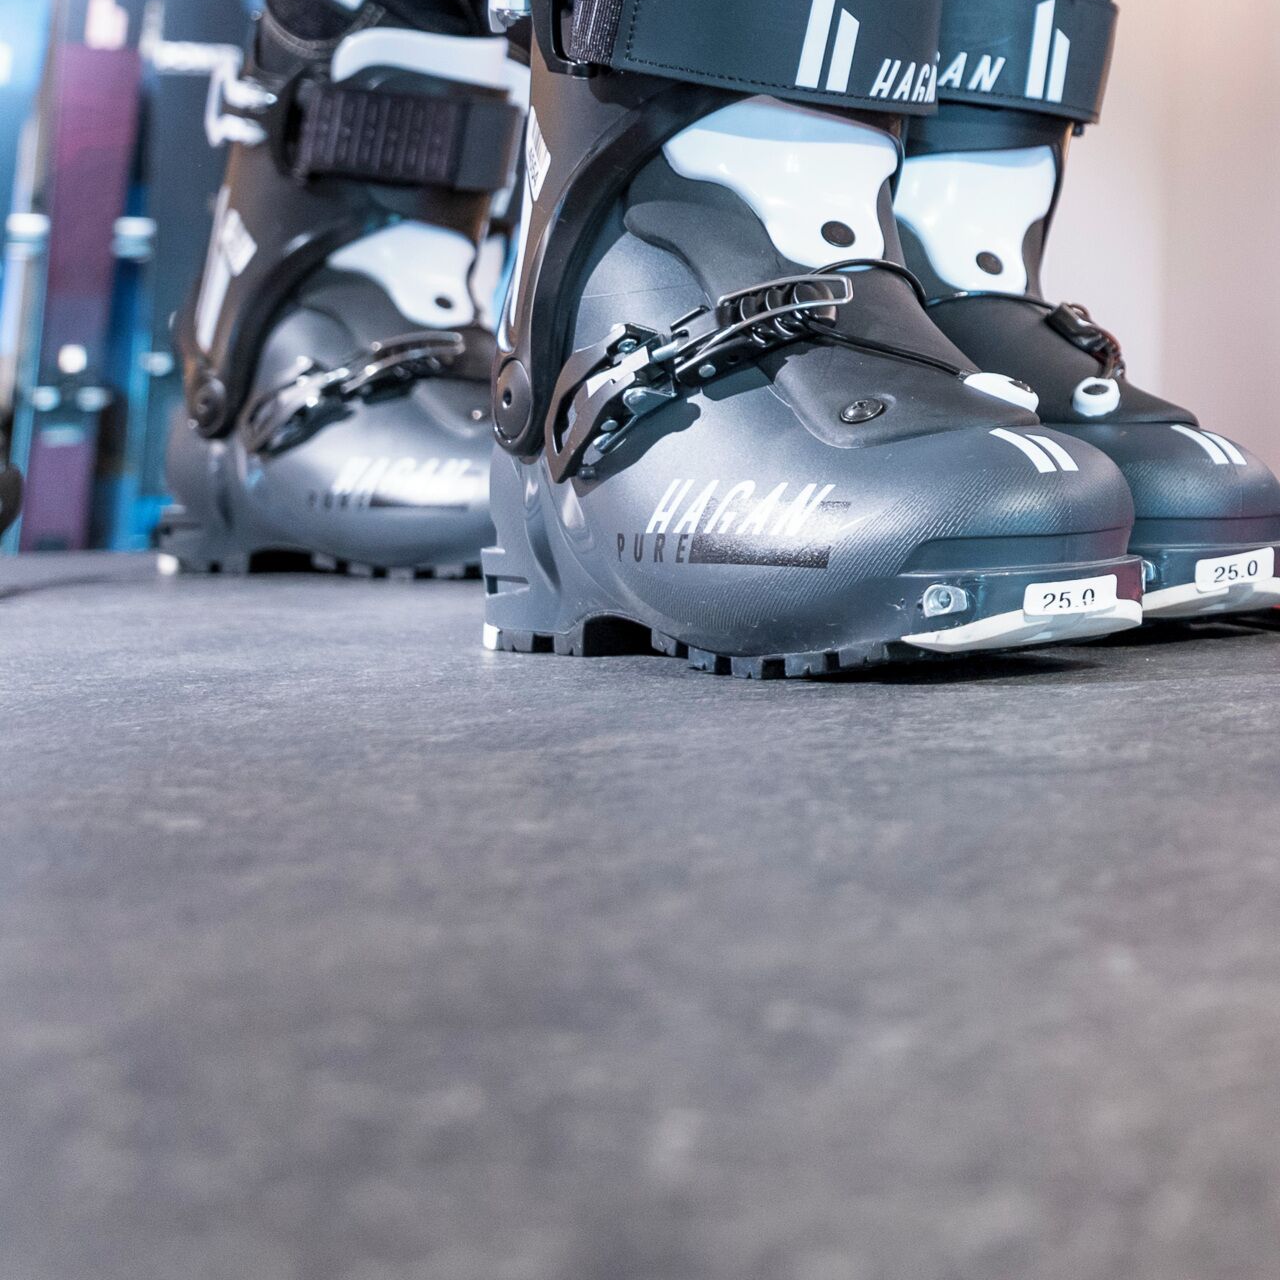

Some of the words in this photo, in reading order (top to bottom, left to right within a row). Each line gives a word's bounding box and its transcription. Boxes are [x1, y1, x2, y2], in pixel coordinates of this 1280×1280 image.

[936, 51, 1006, 92] AN
[645, 478, 836, 536] HAGAN
[616, 533, 690, 564] PURE
[1214, 559, 1259, 584] 25.0
[1042, 587, 1096, 610] 25.0
